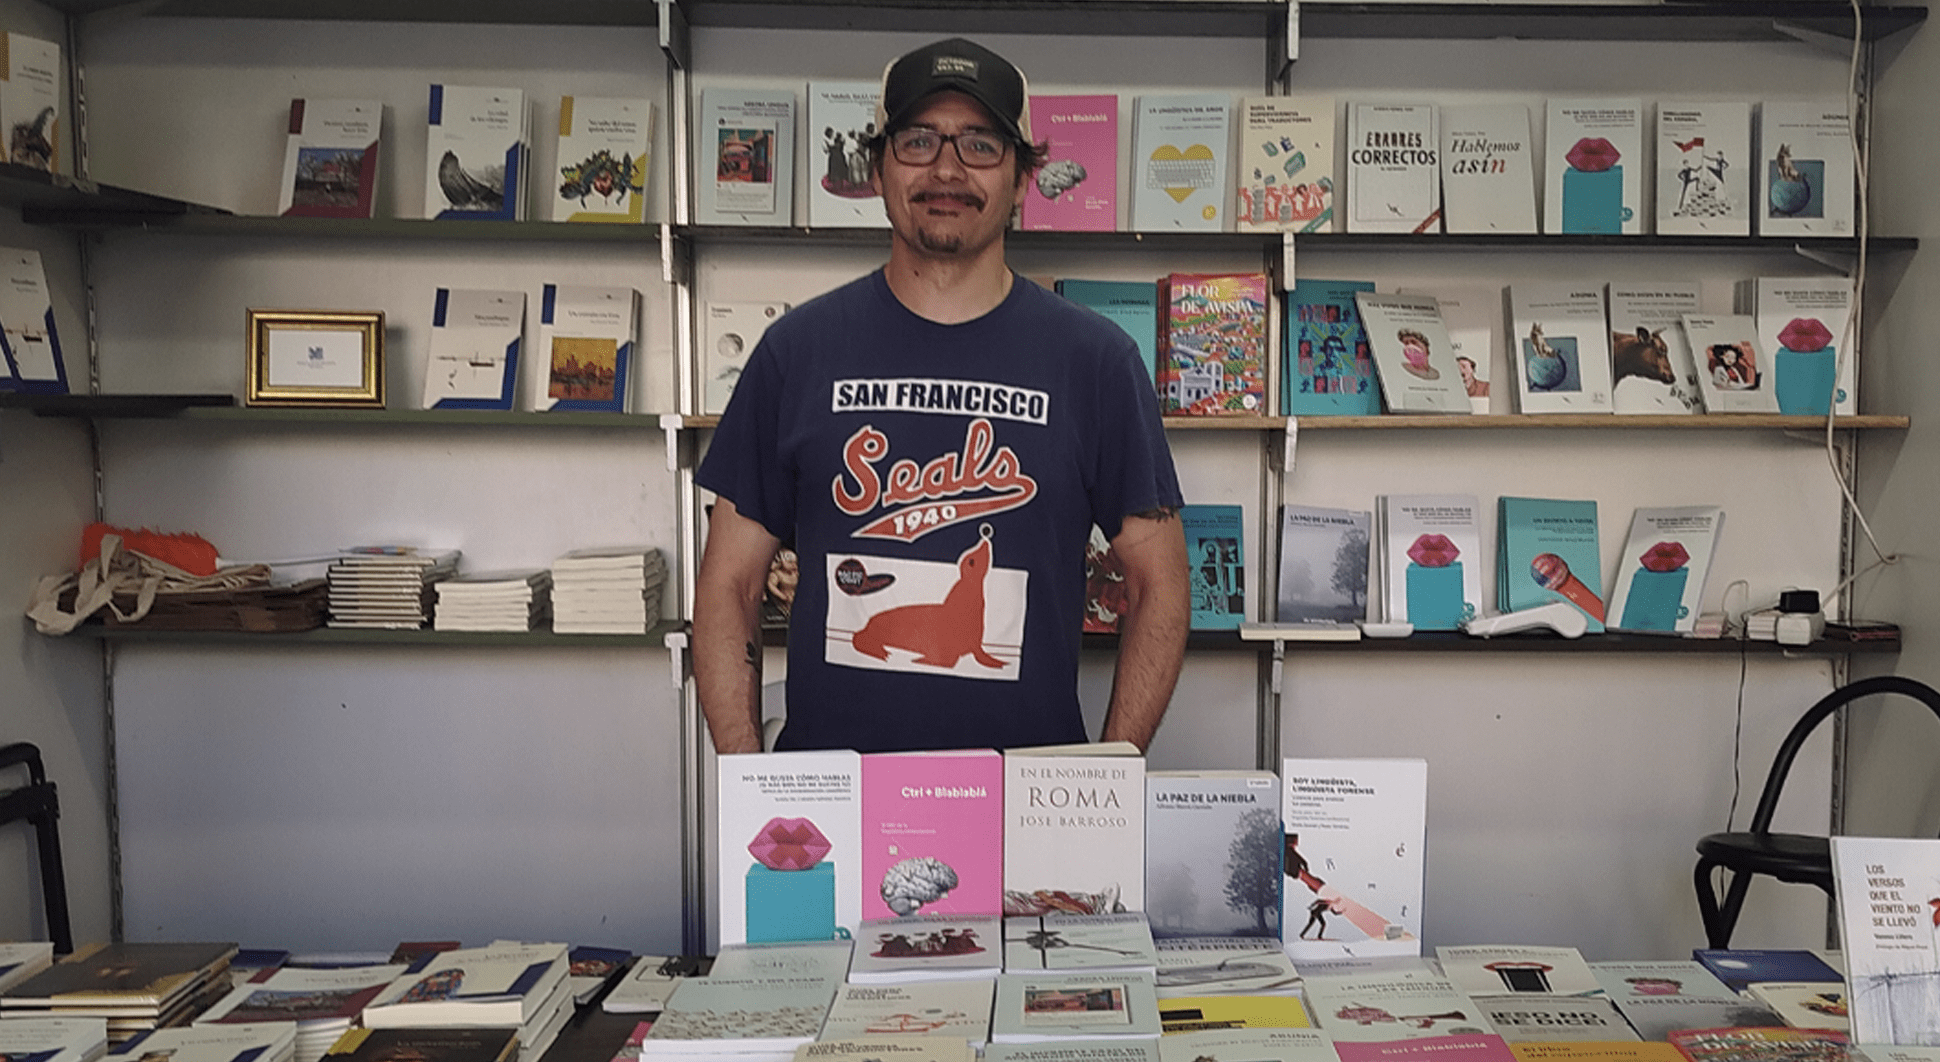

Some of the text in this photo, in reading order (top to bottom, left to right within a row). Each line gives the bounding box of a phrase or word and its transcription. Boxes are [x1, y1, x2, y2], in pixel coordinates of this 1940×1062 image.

[1352, 150, 1437, 165] CORRECTOS
[1181, 284, 1220, 297] FLOR
[1181, 300, 1255, 313] DE AVISPA
[838, 383, 1044, 419] SAN FRANCISCO
[832, 418, 1037, 516] Seals
[893, 504, 957, 535] 1940
[1020, 767, 1126, 779] EN EL NOMBRE DE
[901, 786, 924, 798] Ctrl
[1029, 786, 1121, 809] ROMA
[1156, 793, 1257, 803] LA PAZ DE LA NIEBLA
[1059, 816, 1127, 828] BARROSO
[1866, 865, 1885, 874] LOS
[1868, 878, 1905, 887] VERSOS
[1869, 891, 1902, 900] QUE EL
[1870, 904, 1920, 913] VIENTO NO
[1872, 916, 1917, 926] SE LLEVÓ
